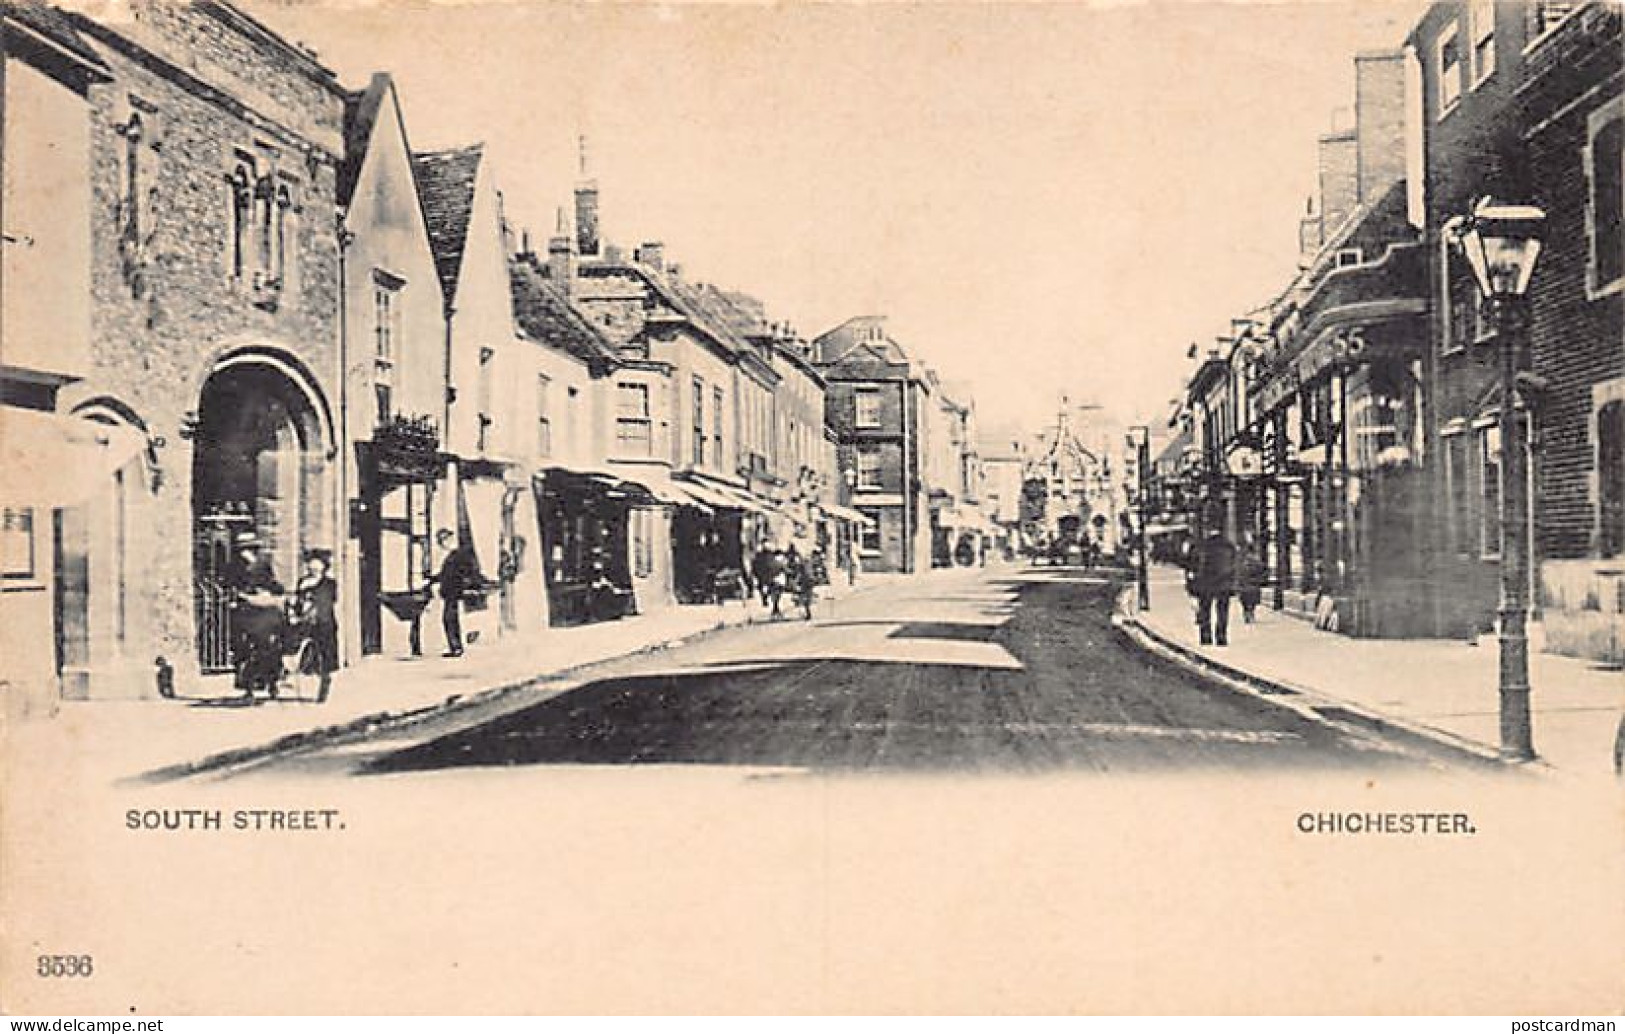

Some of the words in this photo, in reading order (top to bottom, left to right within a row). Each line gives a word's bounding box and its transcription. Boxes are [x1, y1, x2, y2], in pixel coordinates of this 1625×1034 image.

[125, 810, 222, 830] SOUTH
[233, 810, 346, 830] STREET.
[1297, 813, 1476, 834] CHICHESTER.
